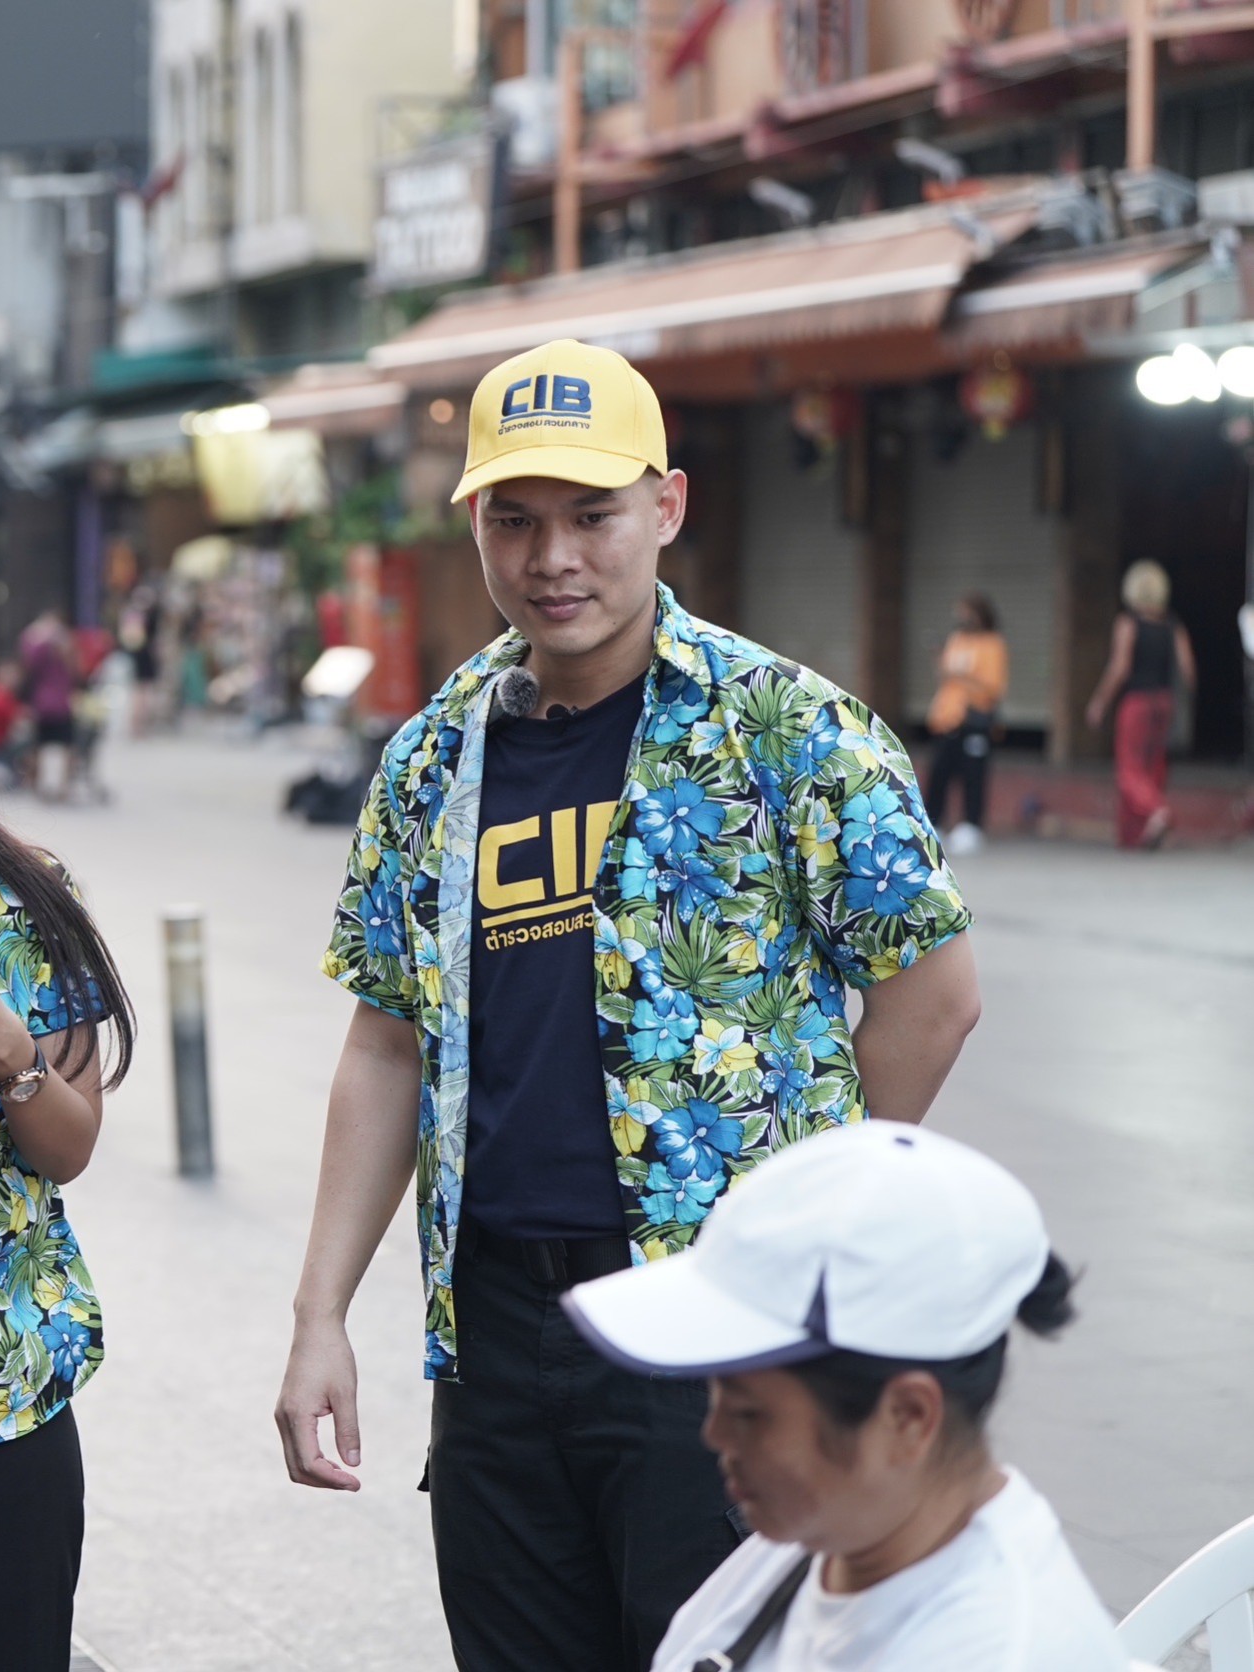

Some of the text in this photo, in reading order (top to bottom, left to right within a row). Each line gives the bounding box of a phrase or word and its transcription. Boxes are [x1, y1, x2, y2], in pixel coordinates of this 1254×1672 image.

[501, 374, 592, 417] CIB
[498, 419, 591, 436] ตำรวจสอบสวนกลาง
